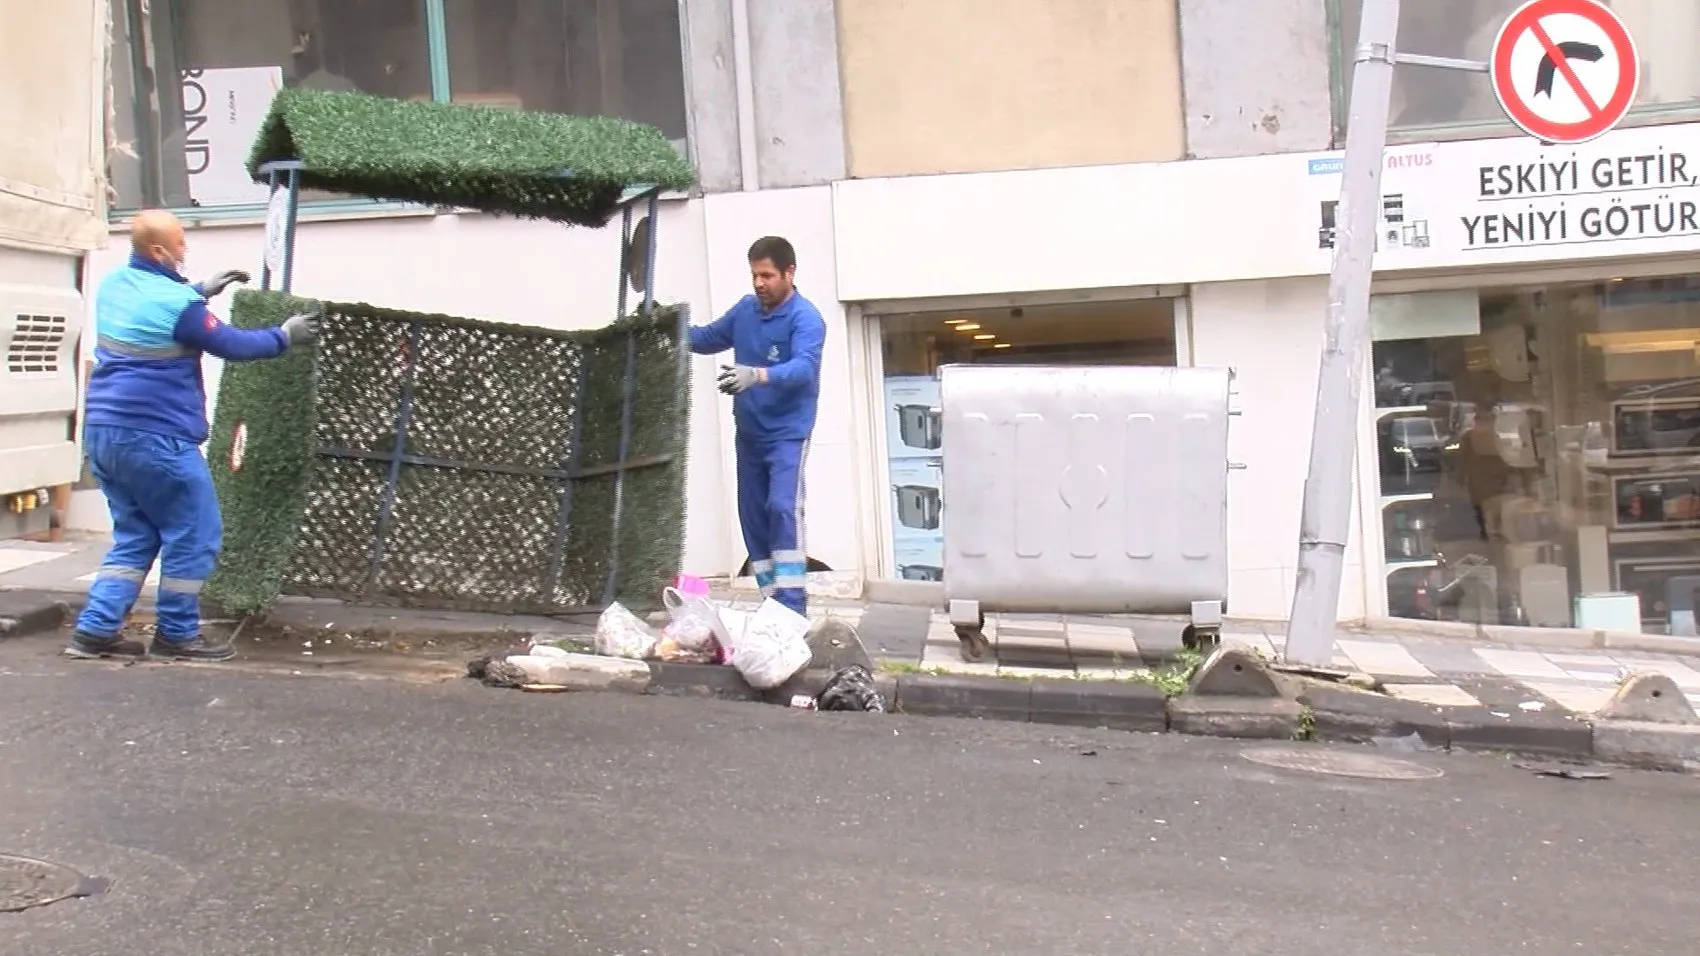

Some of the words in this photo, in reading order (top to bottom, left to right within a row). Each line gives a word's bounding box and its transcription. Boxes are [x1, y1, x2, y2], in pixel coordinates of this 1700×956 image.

[1387, 153, 1433, 169] ALTUS
[1479, 152, 1578, 196] ESKİYİ
[1591, 145, 1698, 187] GETİR,
[1461, 201, 1566, 245] YENİYİ
[1580, 194, 1699, 238] GÖTÜR
